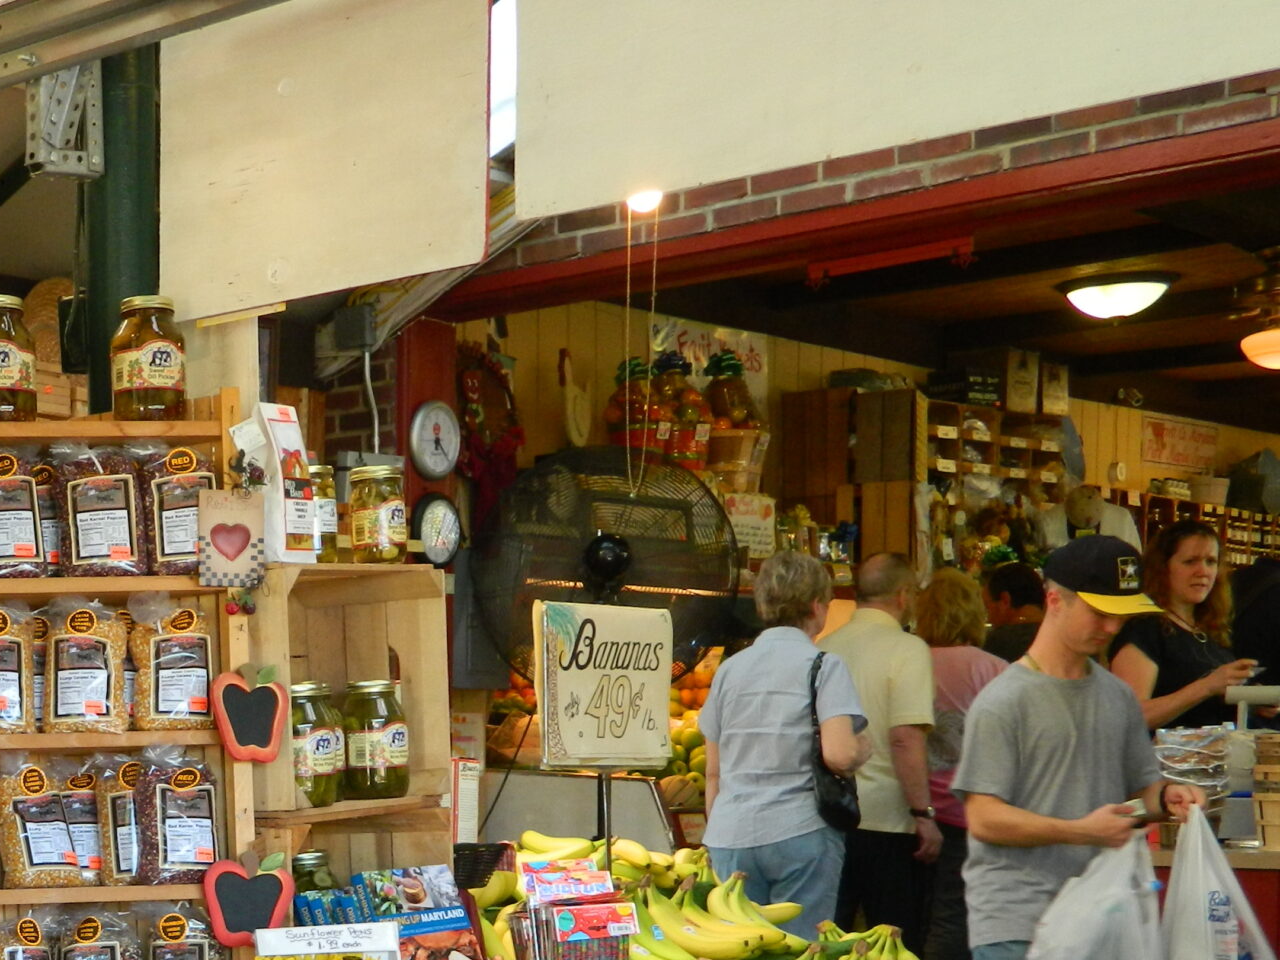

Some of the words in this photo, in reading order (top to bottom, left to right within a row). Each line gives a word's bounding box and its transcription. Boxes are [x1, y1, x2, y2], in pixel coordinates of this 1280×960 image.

[171, 456, 190, 466] RED
[558, 618, 664, 672] Bananas
[177, 774, 195, 782] RED
[412, 914, 422, 924] UP
[421, 907, 466, 923] MARYLAND
[285, 928, 344, 939] Sunflower
